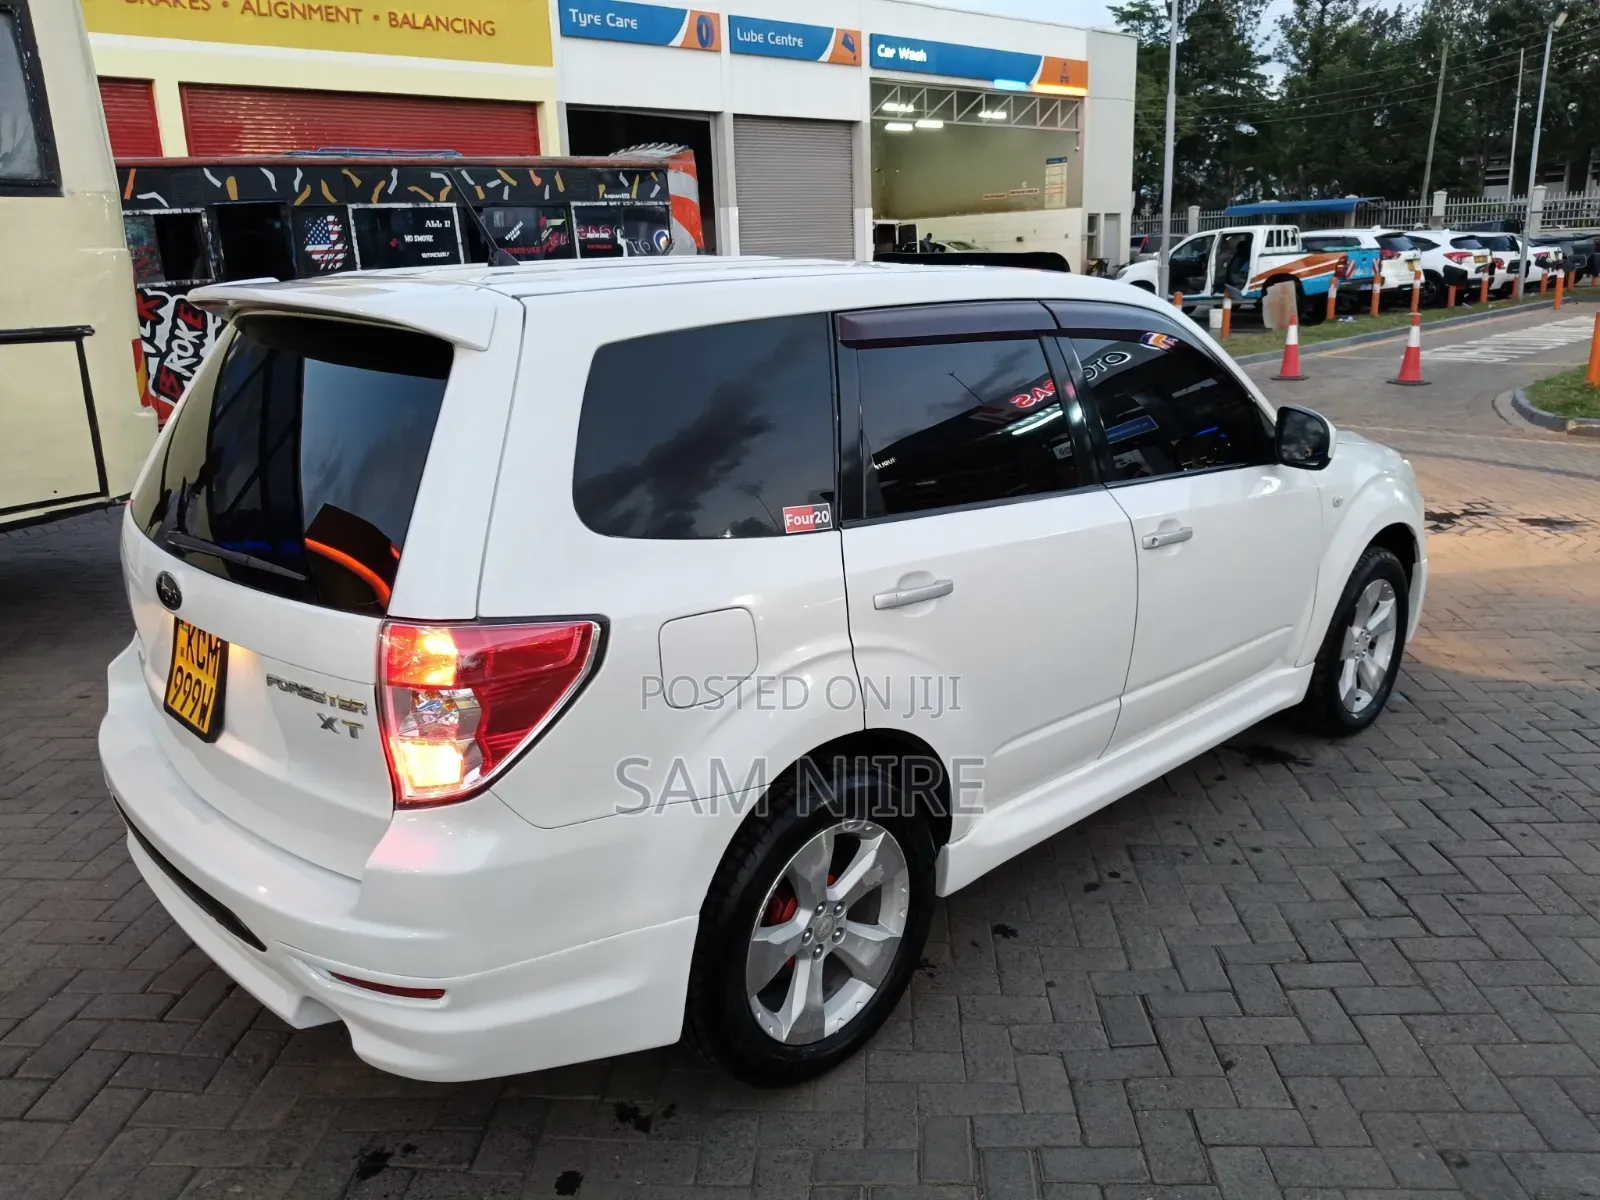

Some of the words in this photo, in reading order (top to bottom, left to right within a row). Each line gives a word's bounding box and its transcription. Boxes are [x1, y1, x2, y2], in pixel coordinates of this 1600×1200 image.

[125, 0, 211, 11] AKES
[240, 0, 363, 25] ALIGNMENT
[388, 11, 496, 37] BALANCING
[569, 8, 601, 27] Tyre
[606, 13, 638, 29] Care
[736, 28, 764, 43] Lube
[767, 32, 804, 48] Centre
[877, 44, 896, 59] Car
[899, 47, 927, 62] Wash
[158, 303, 203, 398] BROKE
[785, 510, 830, 527] Four20
[186, 624, 221, 681] KCM
[170, 665, 215, 728] 999W
[266, 673, 369, 716] FORESTER
[316, 712, 365, 739] XT
